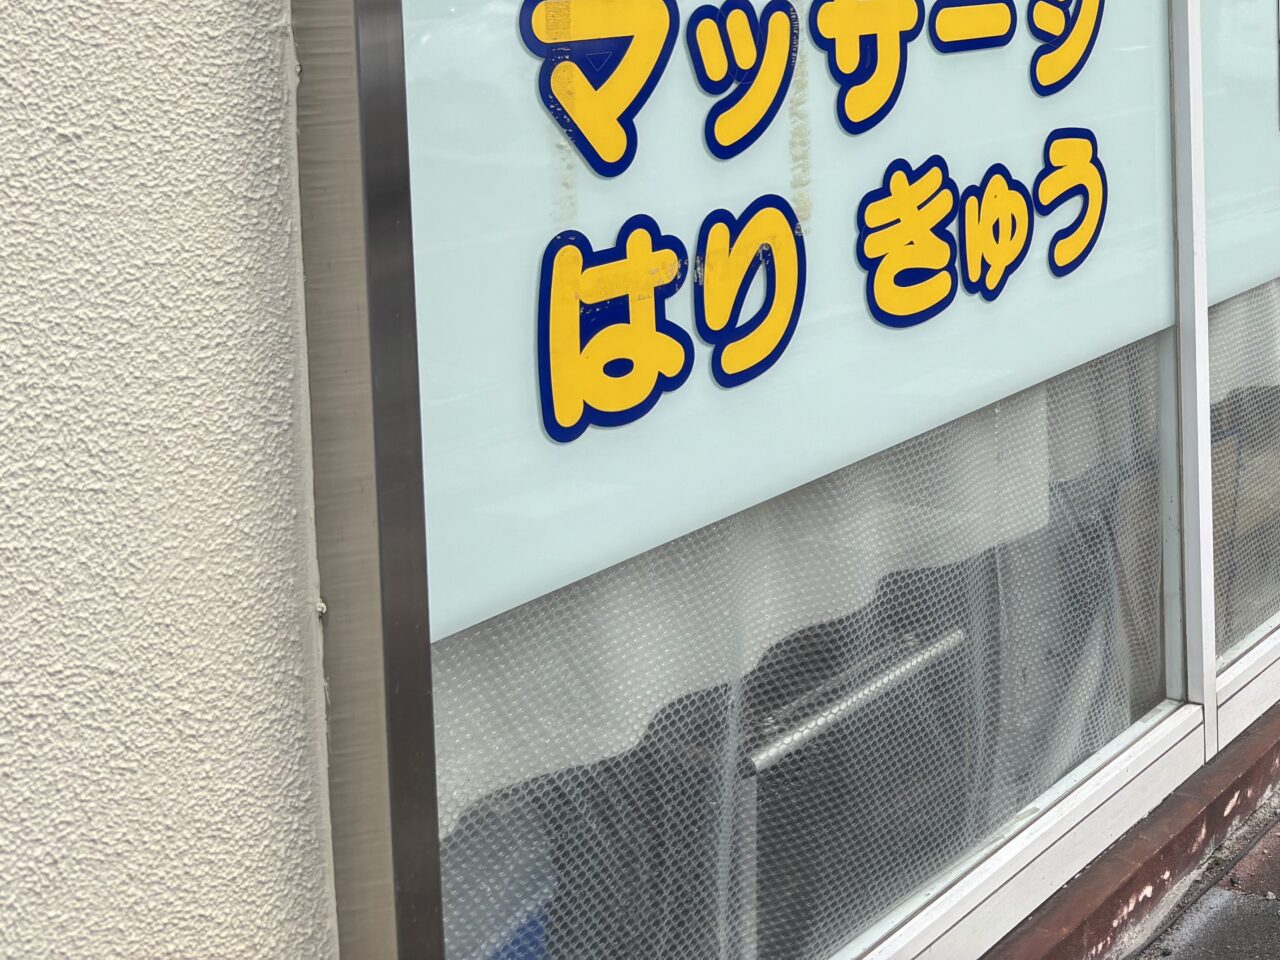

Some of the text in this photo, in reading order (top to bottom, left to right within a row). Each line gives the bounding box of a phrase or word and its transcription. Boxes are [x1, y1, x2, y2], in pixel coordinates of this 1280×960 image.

[538, 127, 1109, 443] はり きゅう
